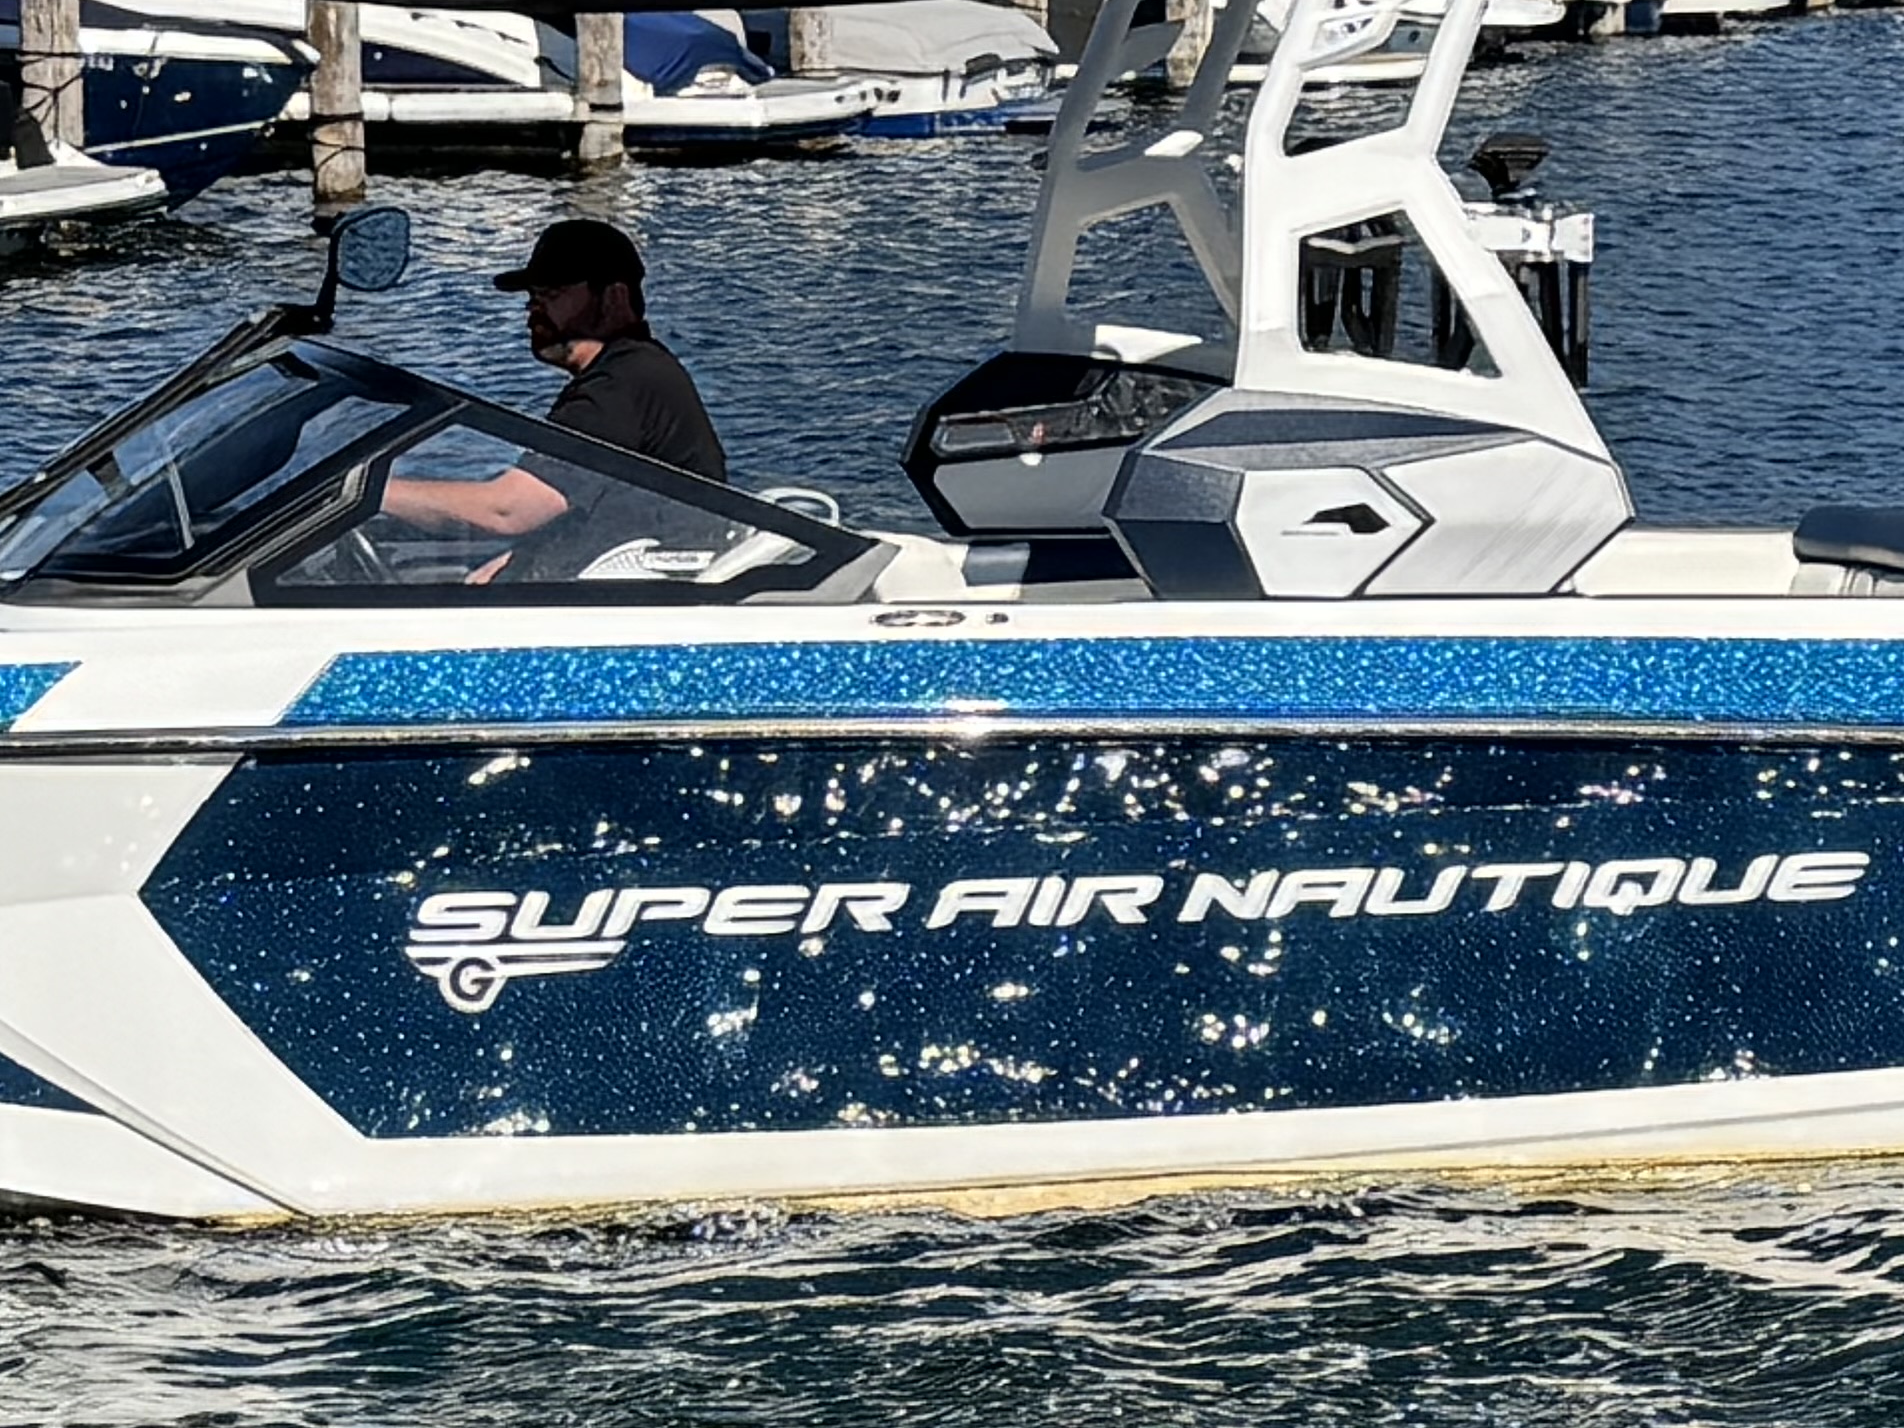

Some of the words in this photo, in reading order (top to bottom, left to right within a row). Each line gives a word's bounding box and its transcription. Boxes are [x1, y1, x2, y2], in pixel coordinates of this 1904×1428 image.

[409, 882, 910, 941] SUPER
[926, 875, 1164, 929] AIR
[1176, 851, 1870, 924] NAUTIQUE
[449, 957, 496, 1002] G
